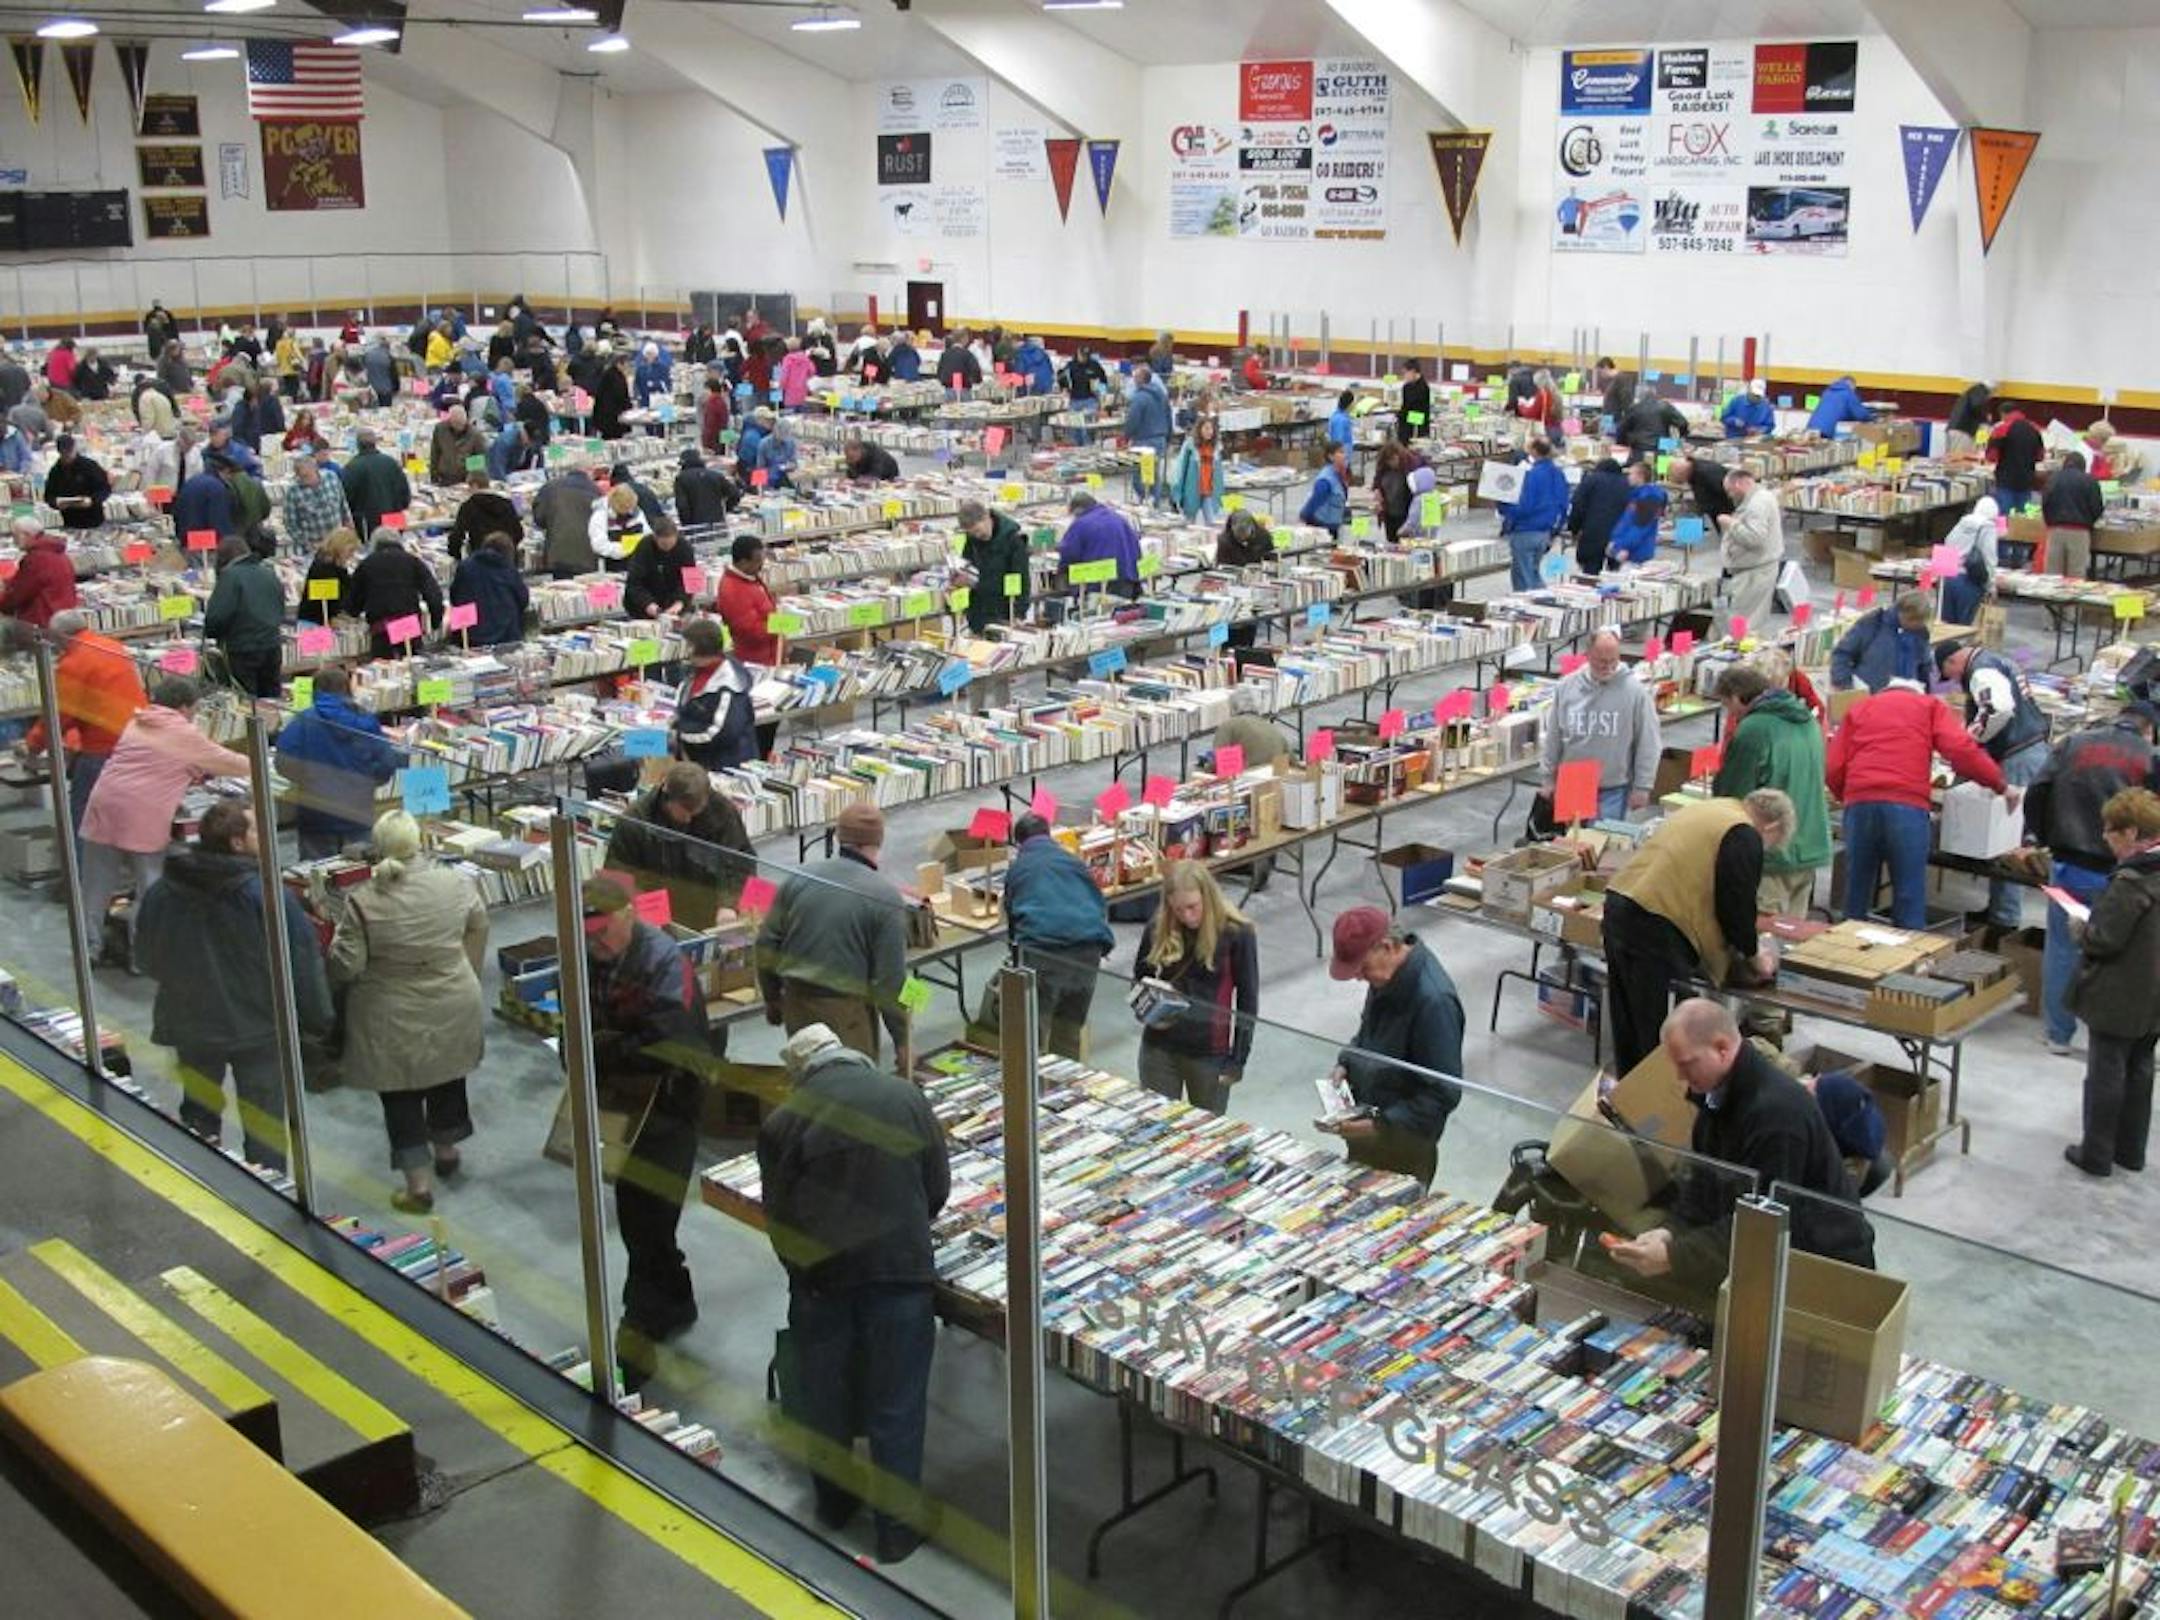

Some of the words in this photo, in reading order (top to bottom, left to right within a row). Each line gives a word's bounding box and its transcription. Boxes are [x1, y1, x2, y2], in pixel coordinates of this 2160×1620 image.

[1333, 75, 1387, 87] GUTH
[1331, 88, 1388, 97] ELECTRIC
[1706, 90, 1734, 100] Luck
[1668, 122, 1730, 155] FOX
[885, 153, 925, 173] RUST
[1316, 162, 1329, 178] GO
[1331, 162, 1375, 178] RAIDERS
[1567, 710, 1620, 737] PEPSI
[1382, 1400, 1610, 1547] GLASS
